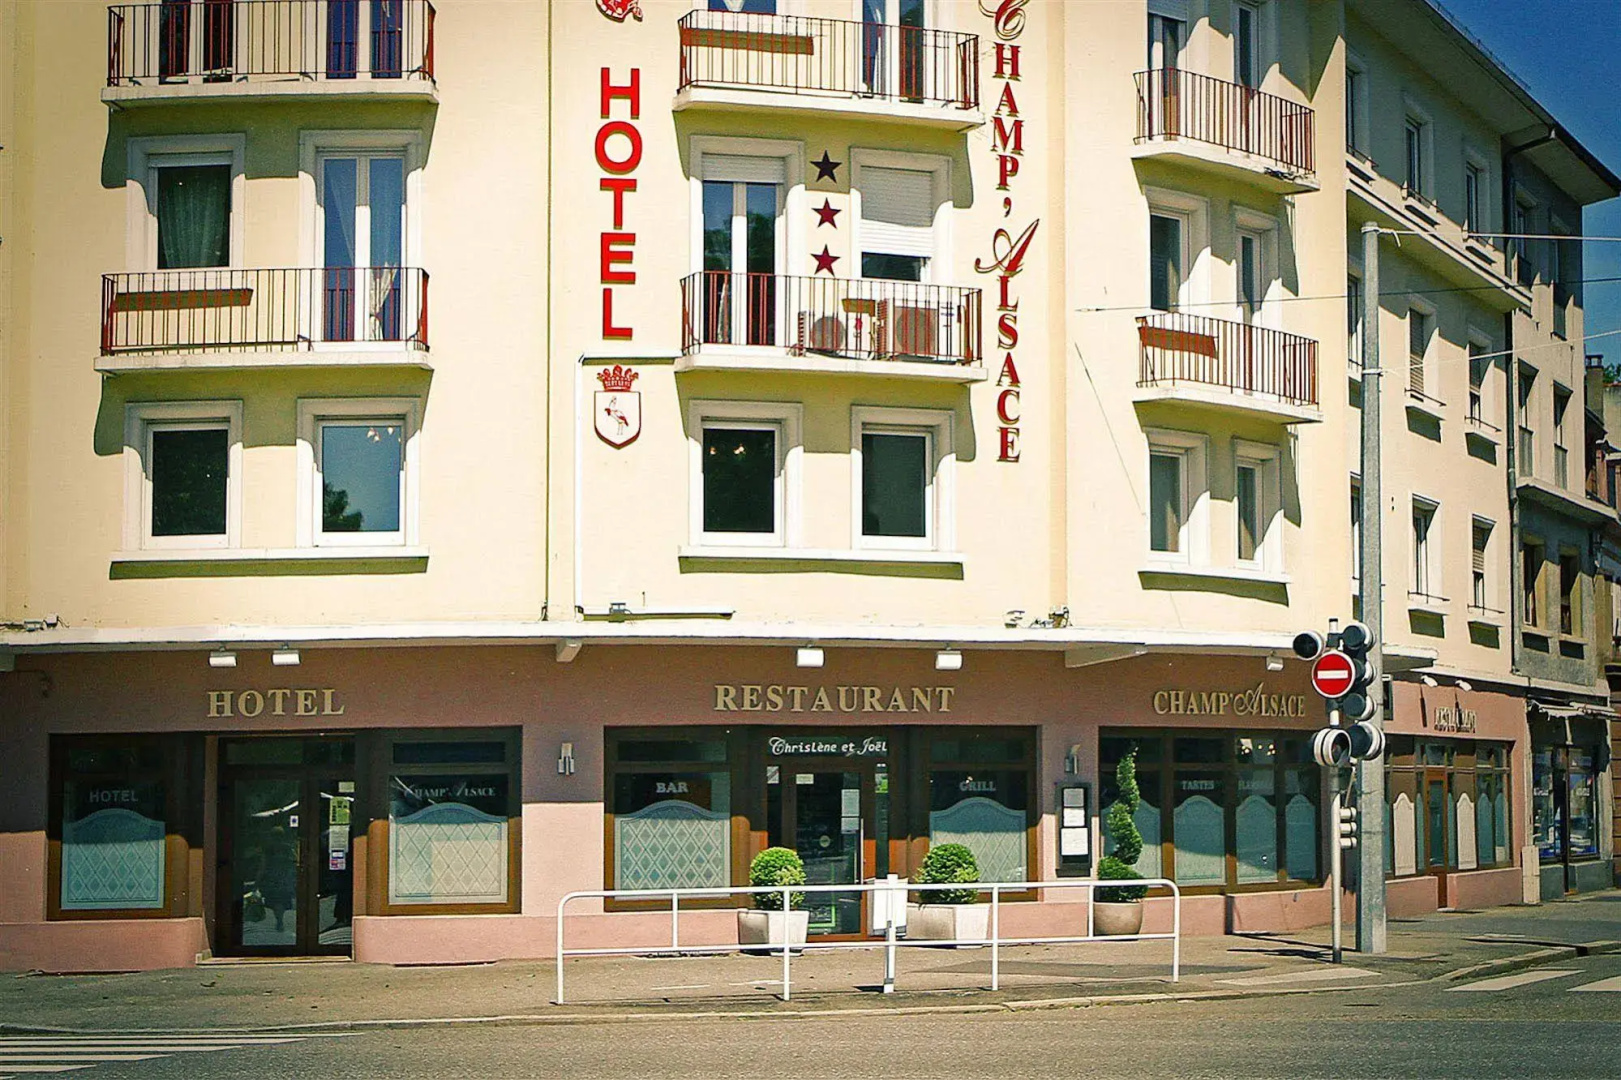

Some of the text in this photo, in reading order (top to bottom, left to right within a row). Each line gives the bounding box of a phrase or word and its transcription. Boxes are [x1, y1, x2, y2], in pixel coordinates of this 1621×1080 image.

[594, 67, 642, 340] HOTEL
[206, 688, 345, 718] HOTEL
[713, 684, 955, 713] RESTAURANT
[768, 736, 888, 756] Chrislène et Joël
[655, 781, 689, 793] BAR
[959, 780, 996, 791] GRILL
[89, 789, 139, 803] HOTEL
